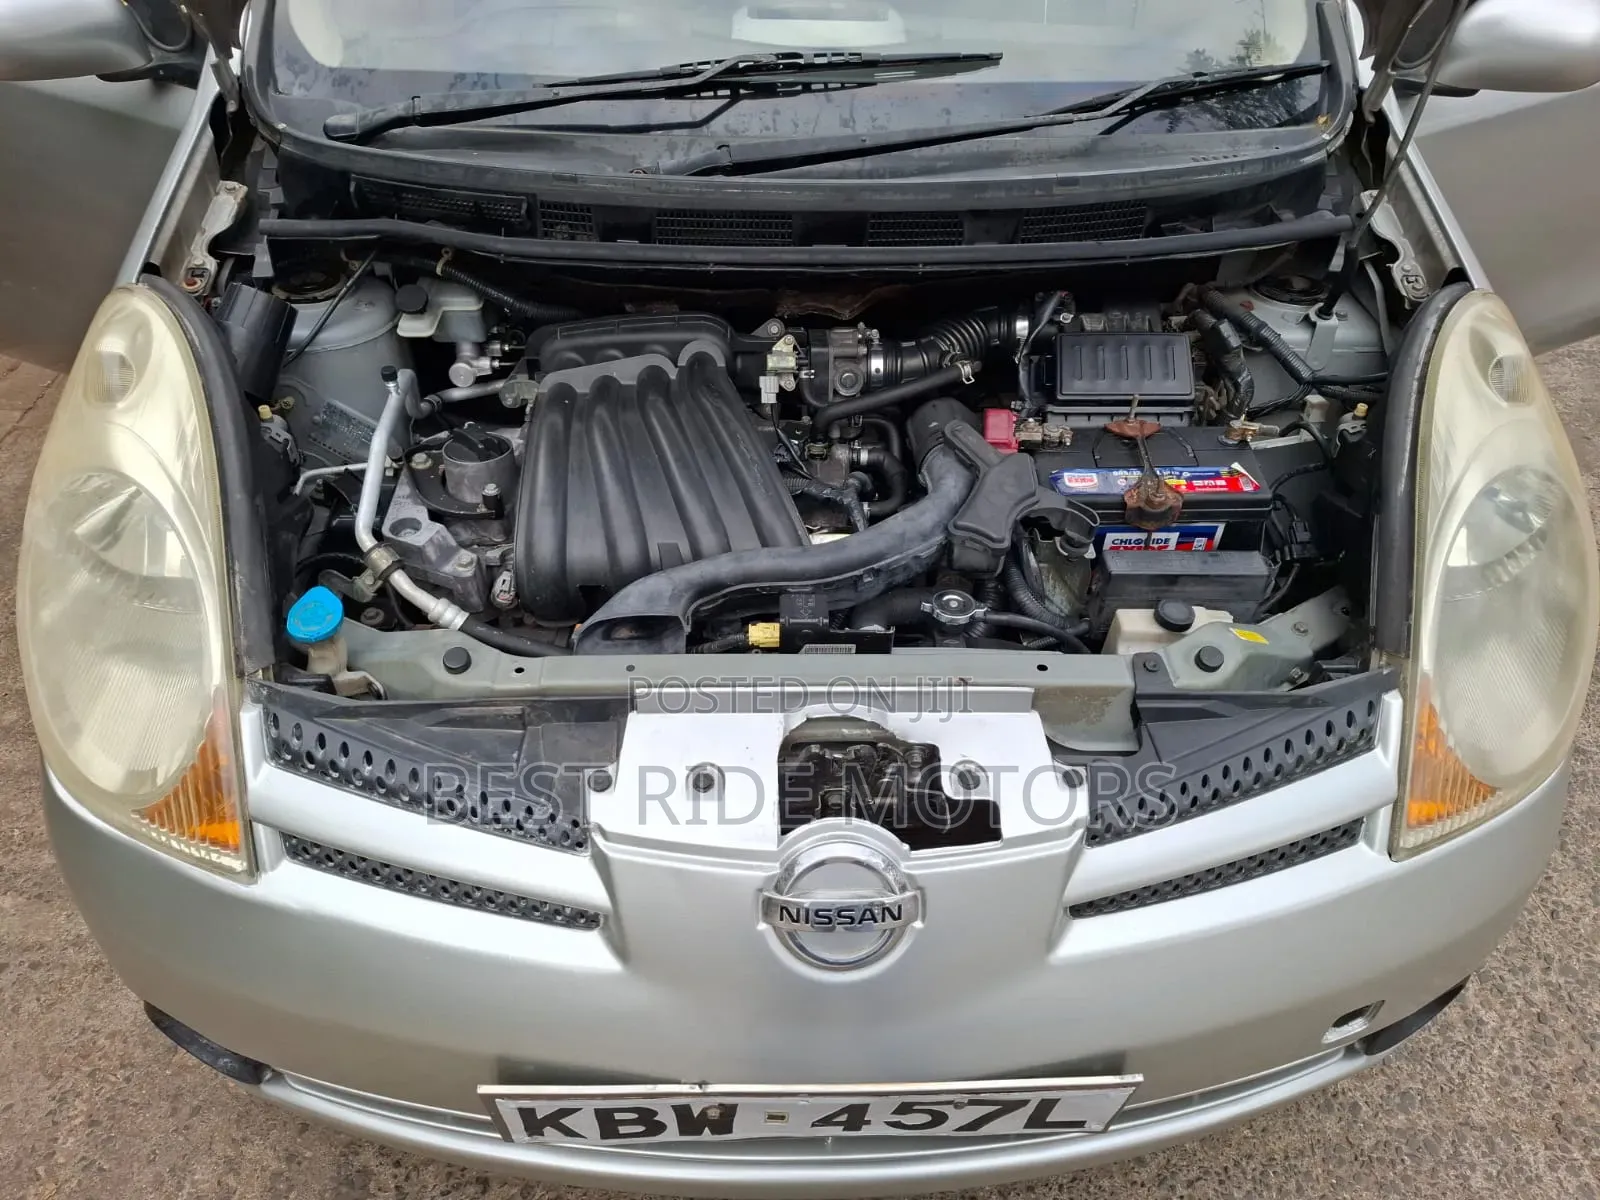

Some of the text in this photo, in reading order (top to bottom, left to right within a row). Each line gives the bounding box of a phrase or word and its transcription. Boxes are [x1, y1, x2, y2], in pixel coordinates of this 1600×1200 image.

[1111, 537, 1170, 546] CHLOIDE
[778, 903, 903, 927] NISSAN
[517, 1098, 1087, 1140] KBW 457L
